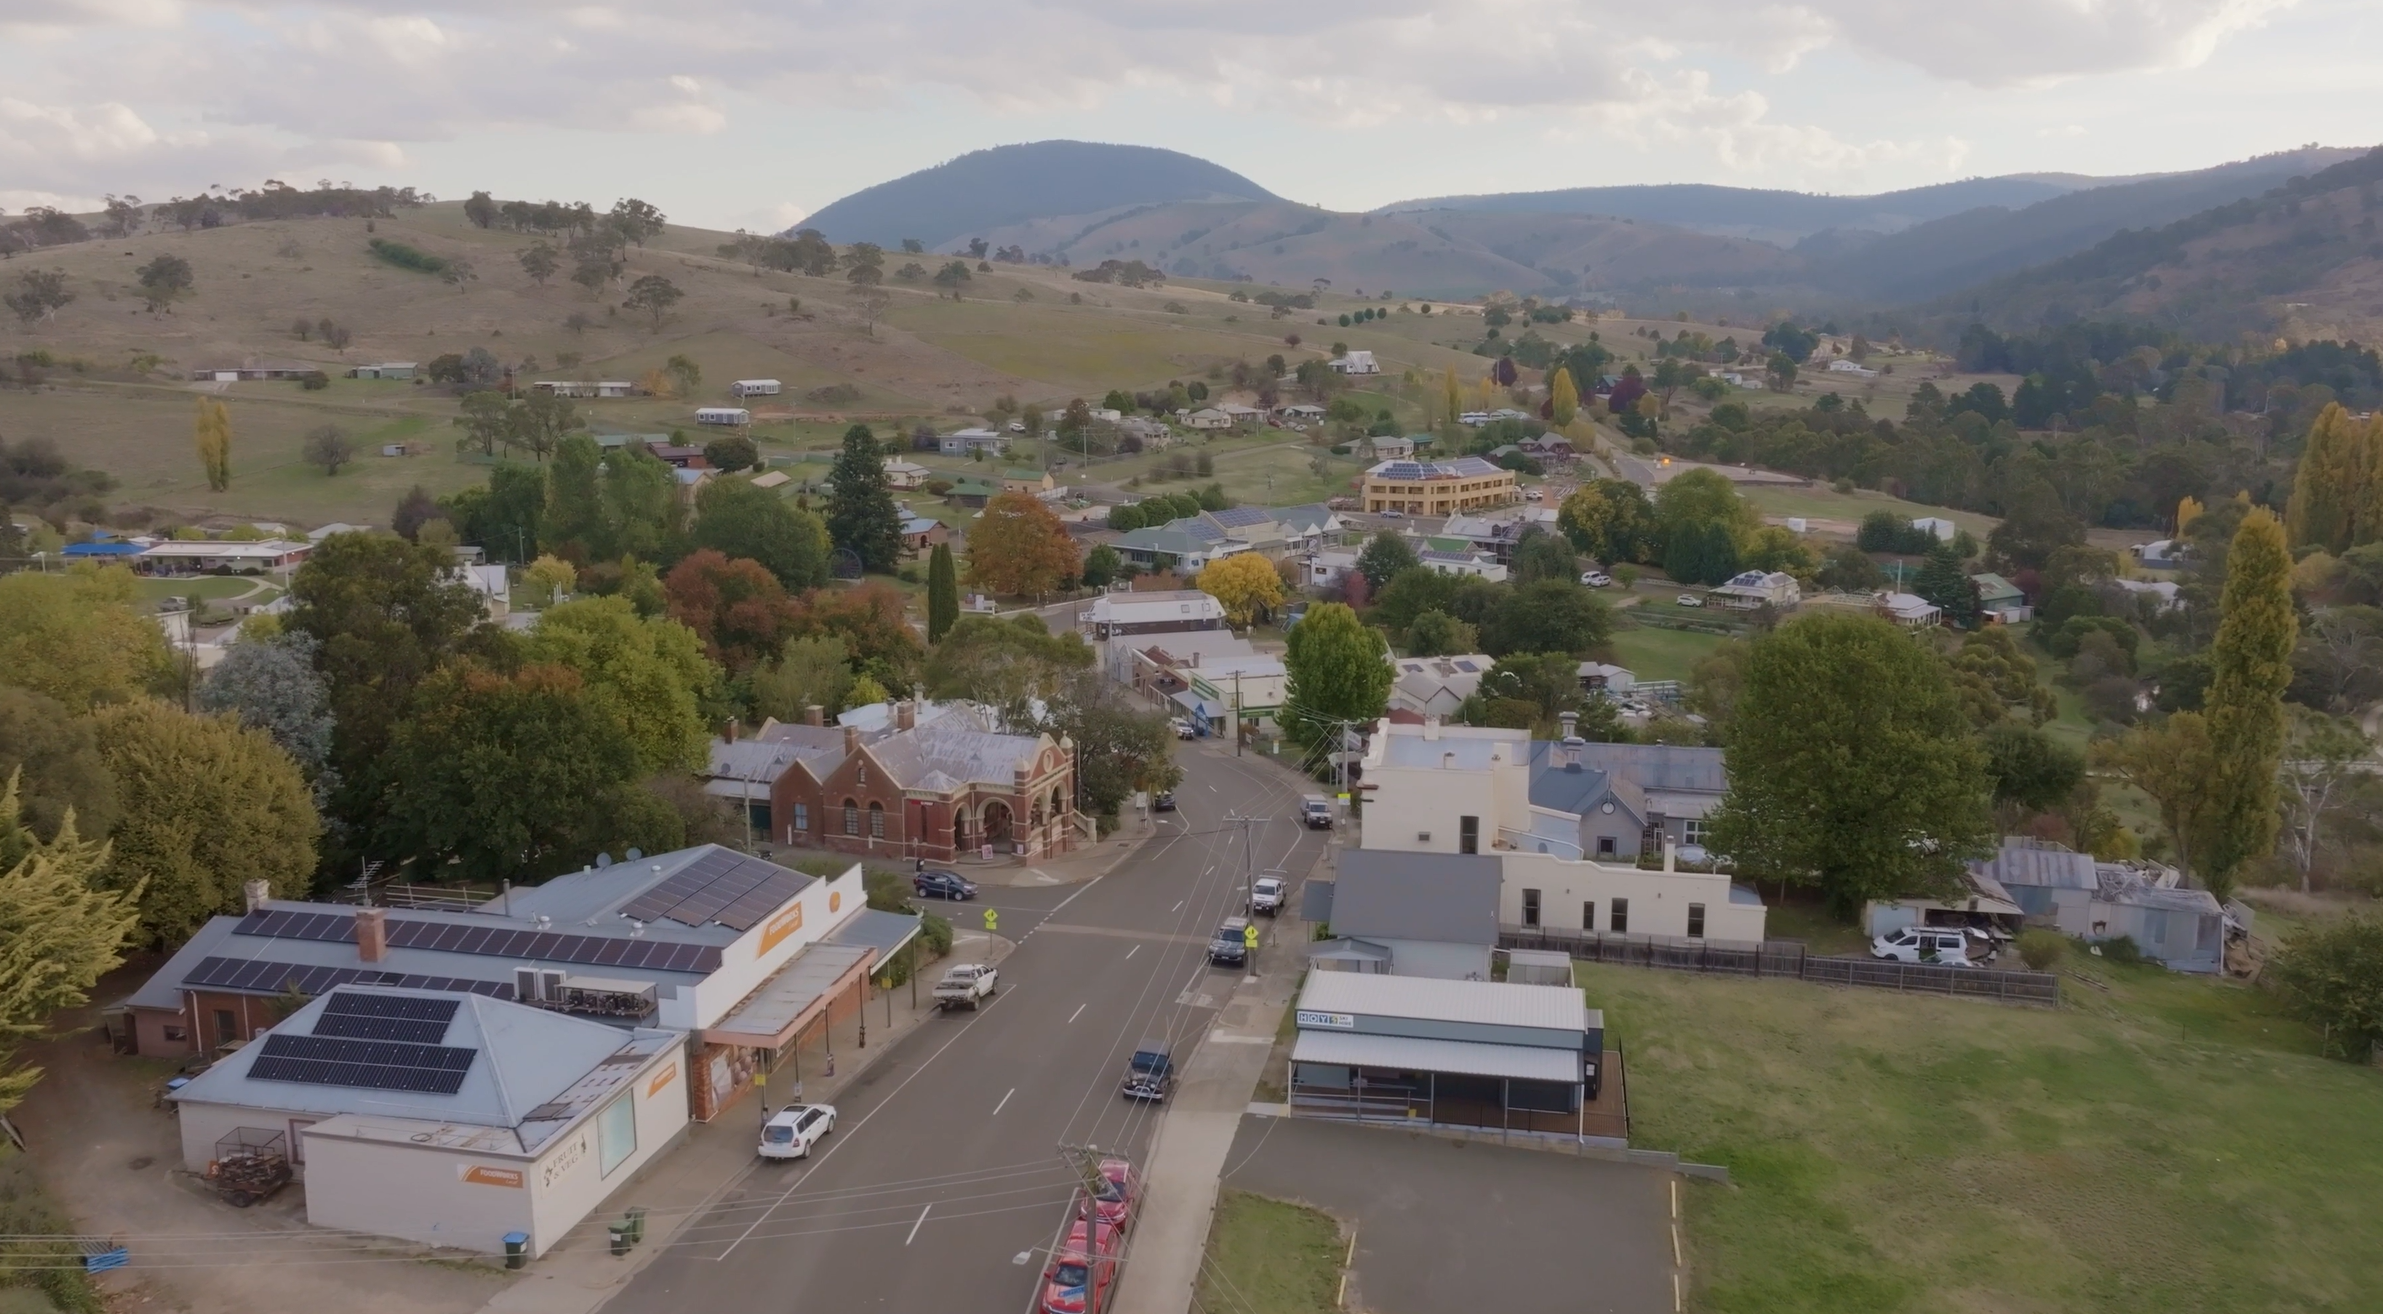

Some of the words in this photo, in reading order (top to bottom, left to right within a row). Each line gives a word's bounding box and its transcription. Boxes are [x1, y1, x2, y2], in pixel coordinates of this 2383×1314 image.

[552, 1141, 578, 1168] FRUIT
[560, 1153, 579, 1172] VEG
[480, 1169, 518, 1180] FOODWORKS
